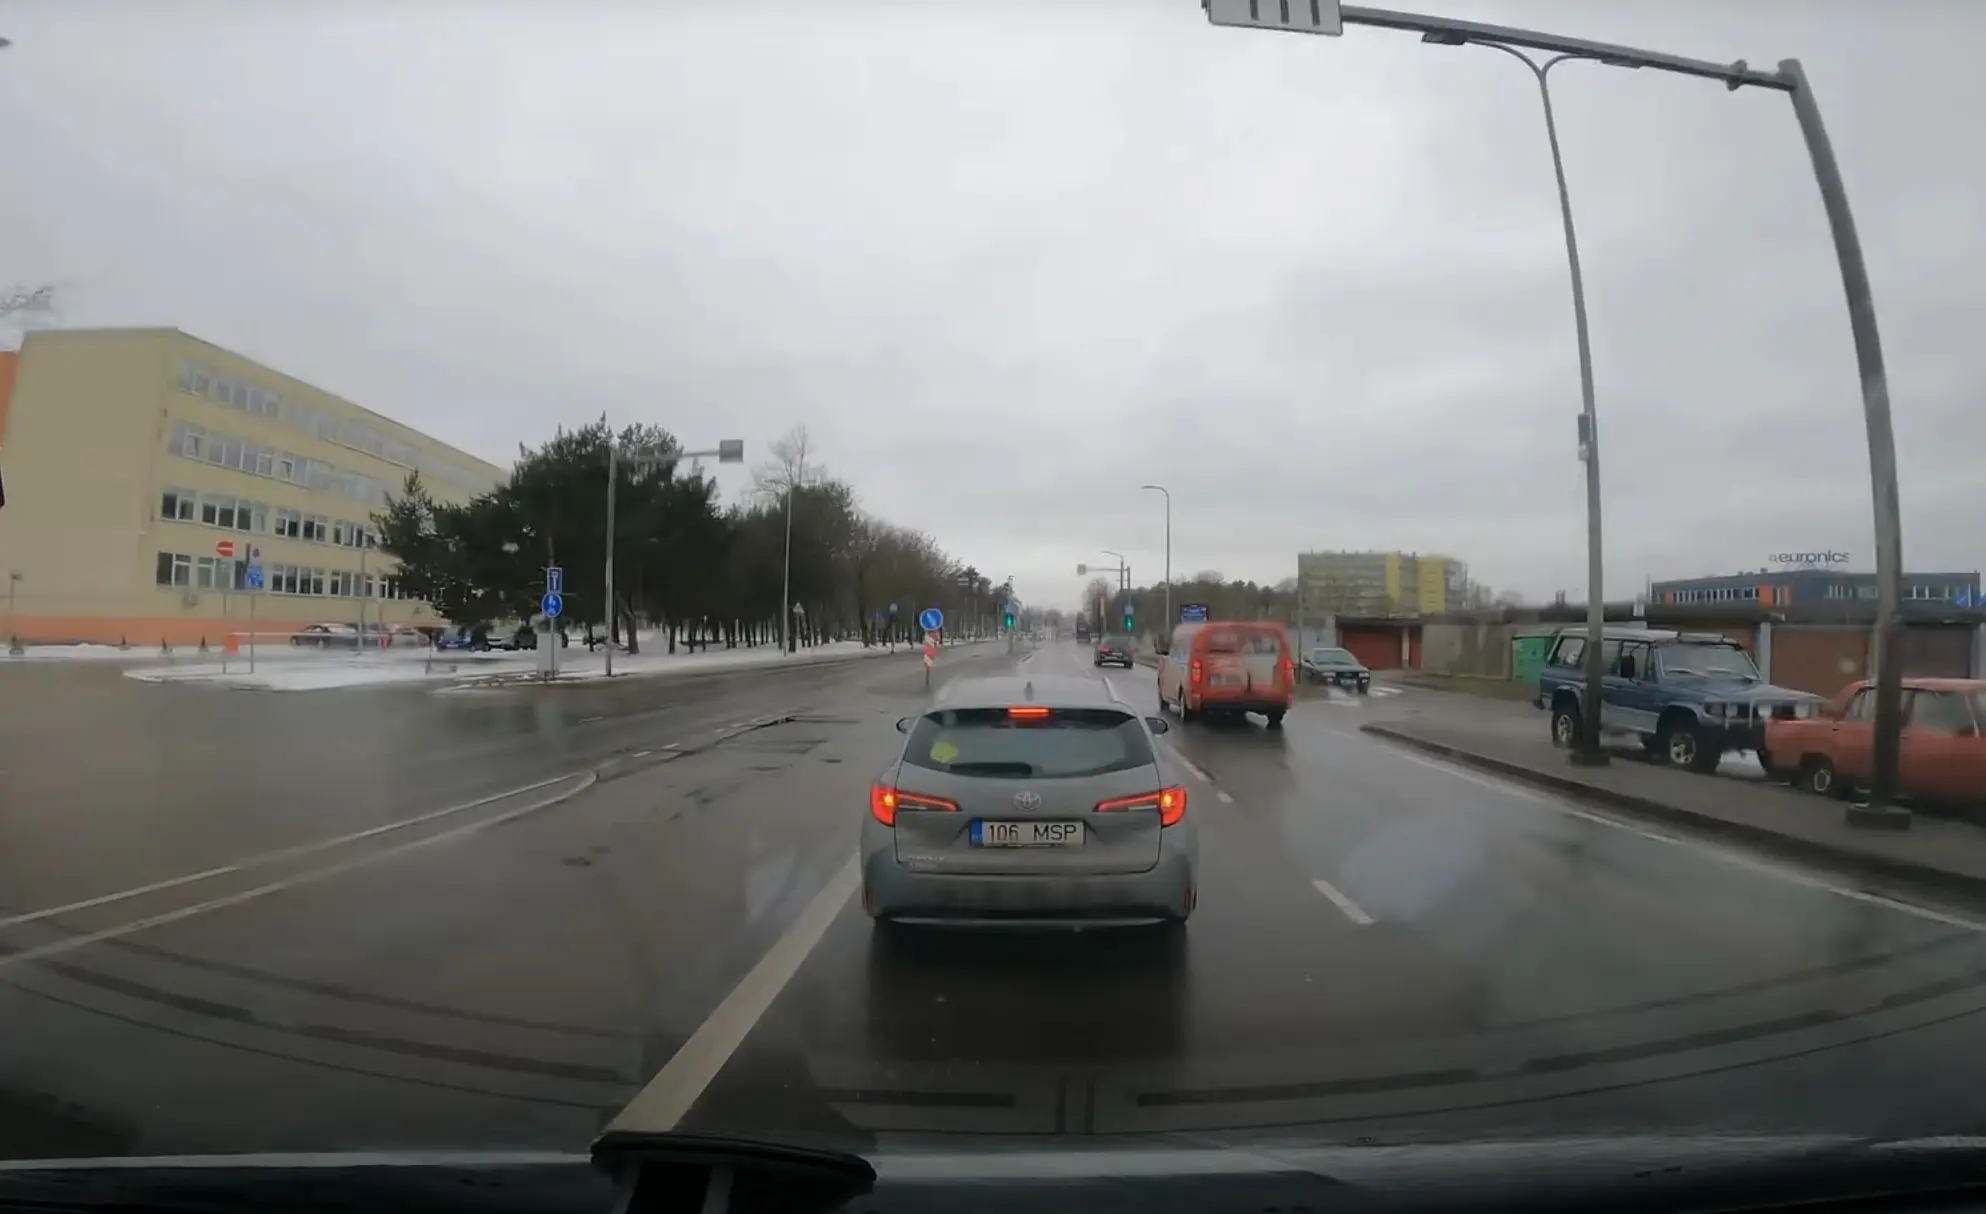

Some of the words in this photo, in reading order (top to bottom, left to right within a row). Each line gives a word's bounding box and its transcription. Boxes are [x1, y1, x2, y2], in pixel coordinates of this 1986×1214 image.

[1779, 548, 1850, 563] euronics
[989, 824, 1019, 841] 106
[1034, 824, 1077, 841] MSP
